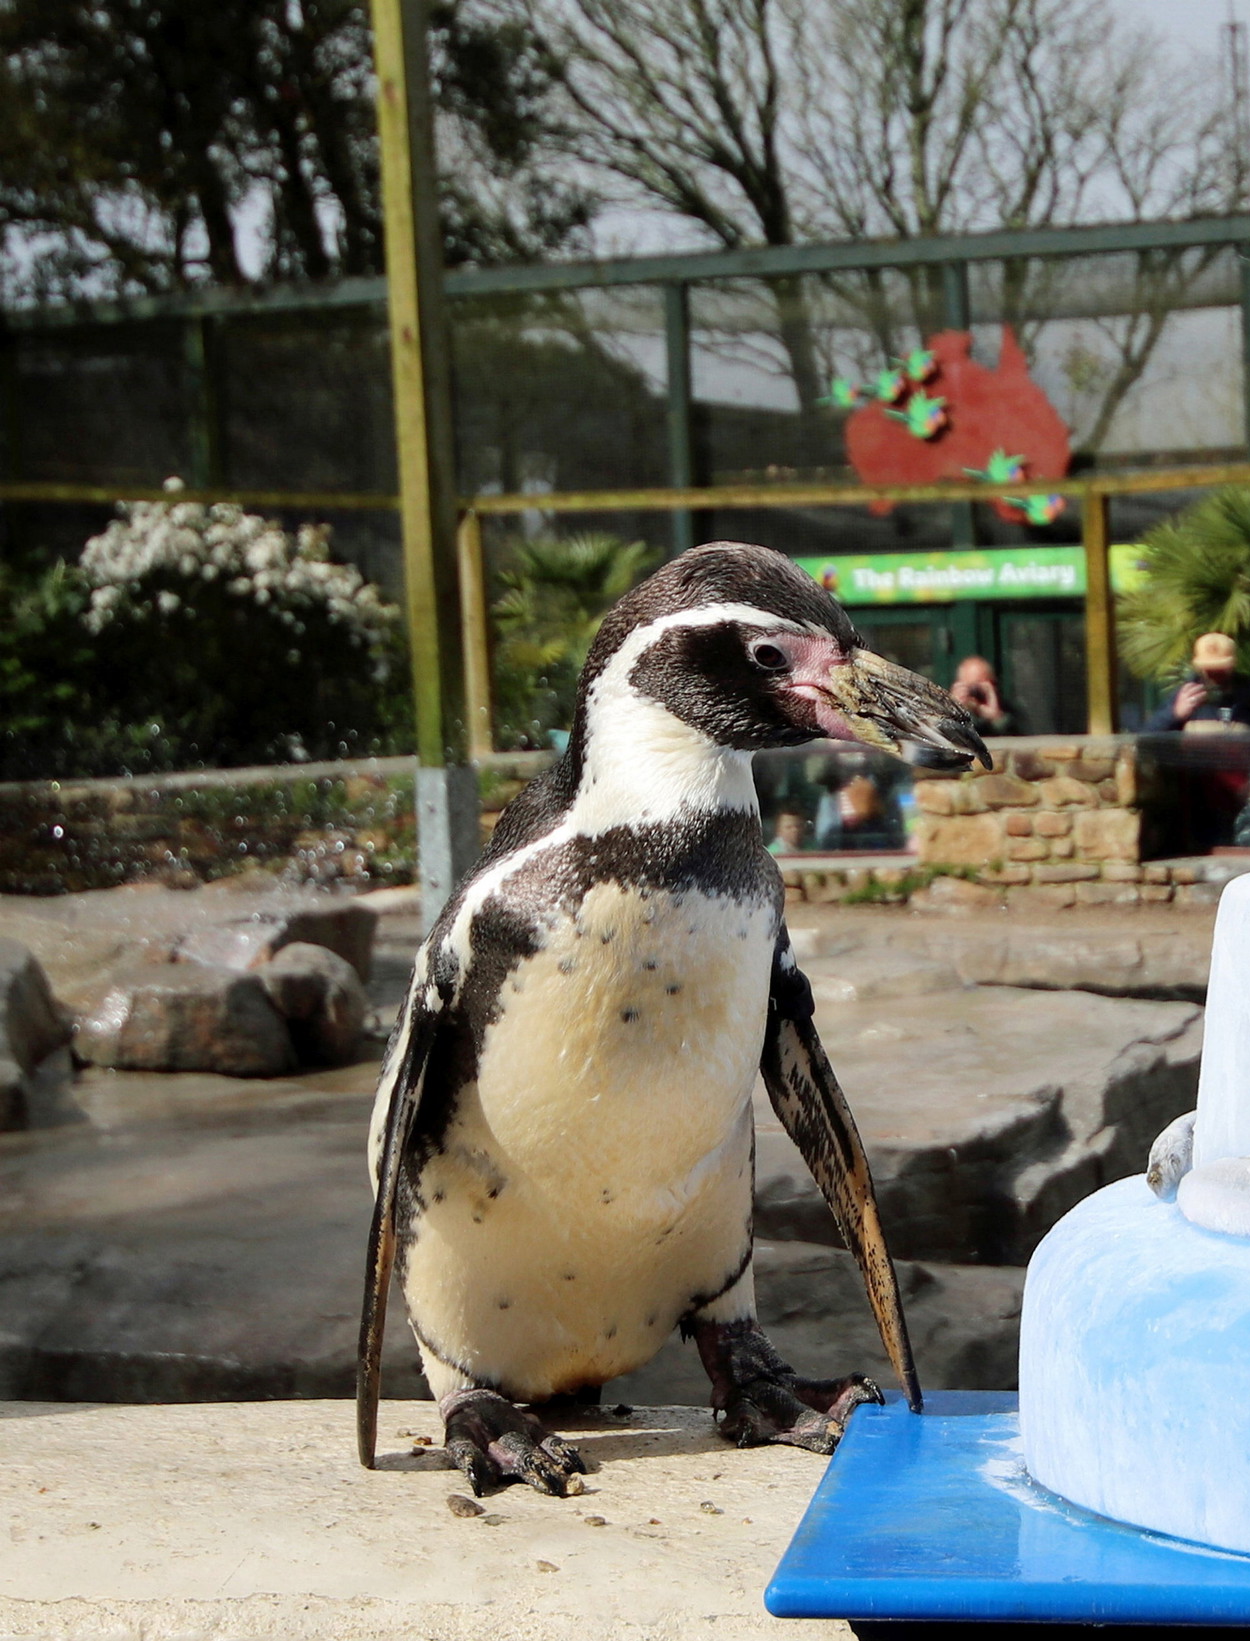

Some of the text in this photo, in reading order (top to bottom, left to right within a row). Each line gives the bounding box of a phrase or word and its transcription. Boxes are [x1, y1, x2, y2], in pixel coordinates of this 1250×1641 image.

[853, 563, 1075, 588] The Rainbow Aviary
